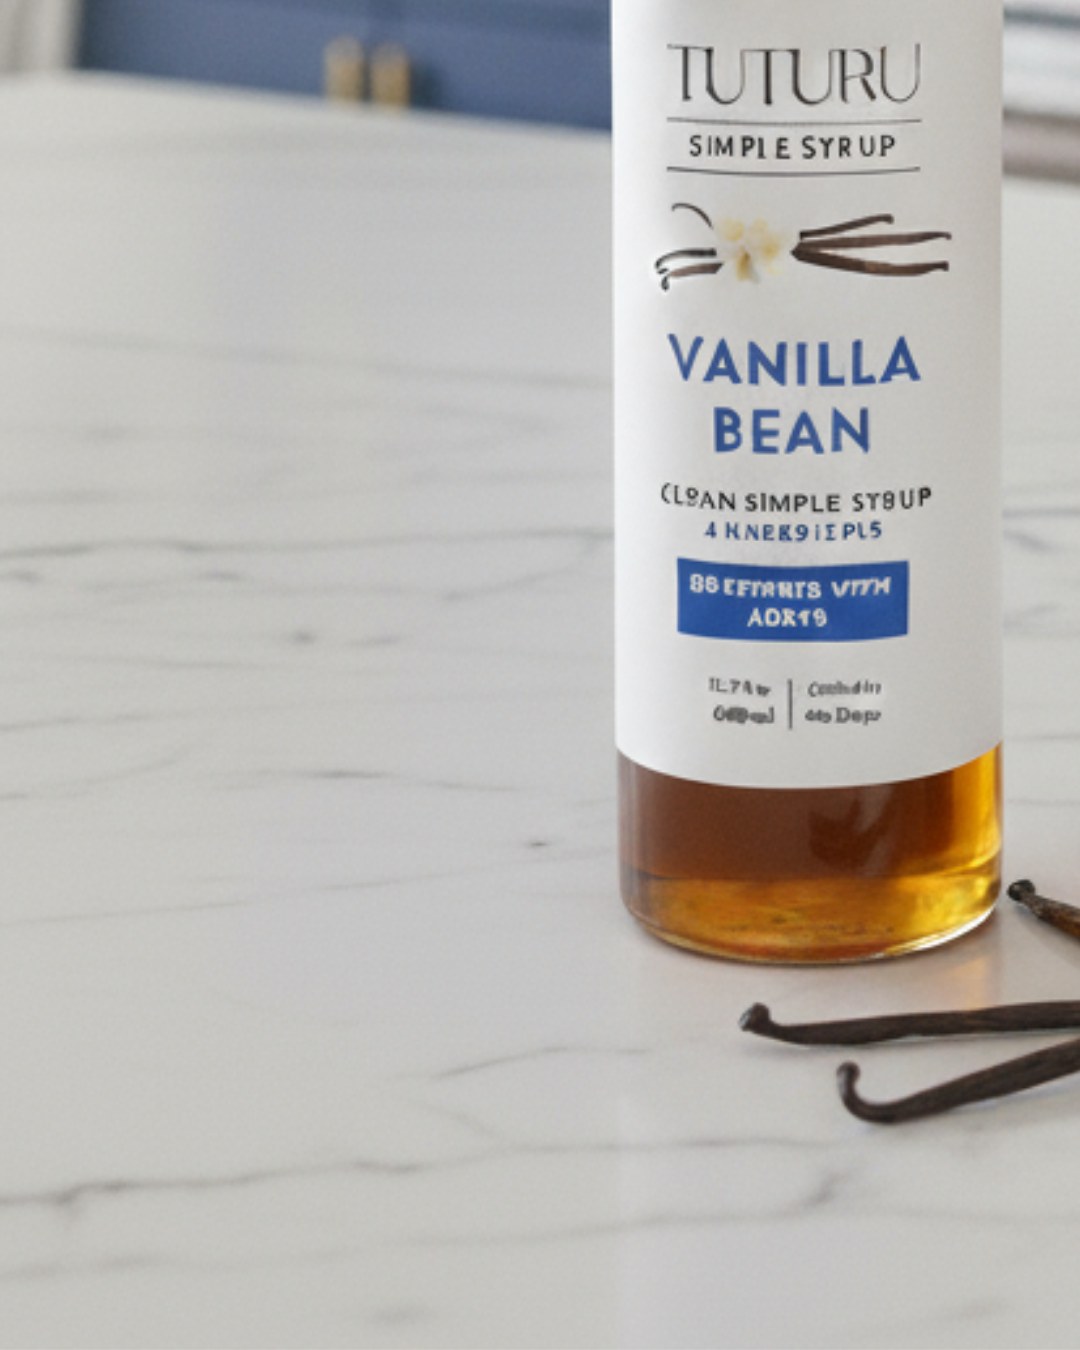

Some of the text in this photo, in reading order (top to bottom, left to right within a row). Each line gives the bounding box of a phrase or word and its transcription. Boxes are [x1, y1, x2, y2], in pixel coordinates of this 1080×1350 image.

[667, 43, 921, 106] TUTURU
[801, 135, 896, 160] SYRUP
[667, 333, 921, 387] VANILLA
[713, 407, 870, 455] BEAN
[744, 492, 841, 513] SIMPLE
